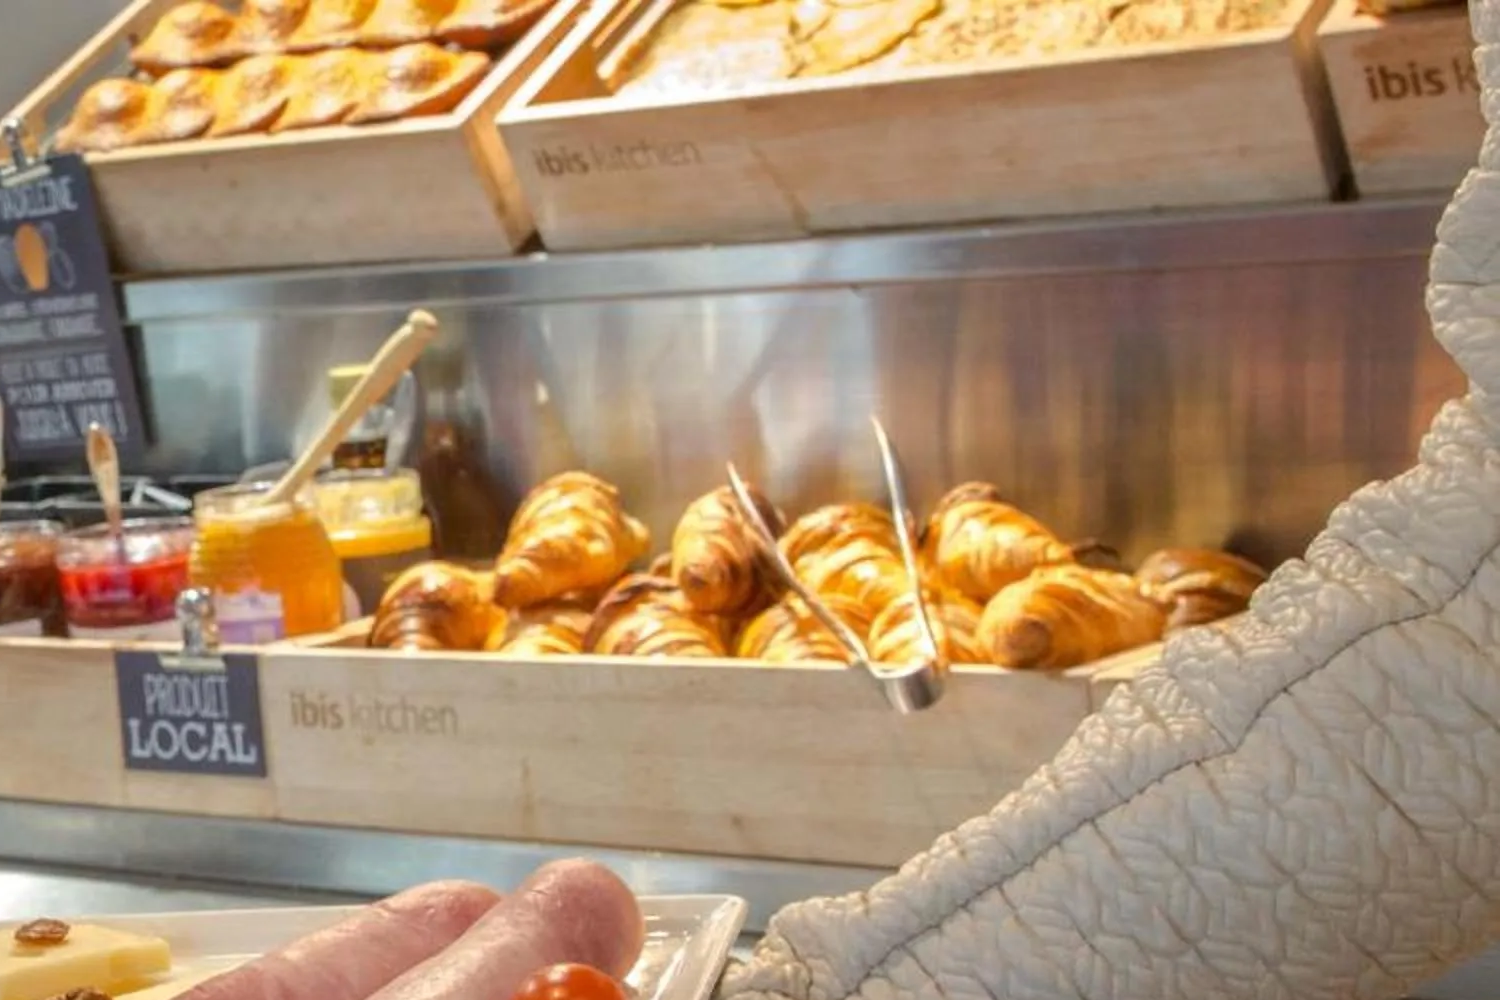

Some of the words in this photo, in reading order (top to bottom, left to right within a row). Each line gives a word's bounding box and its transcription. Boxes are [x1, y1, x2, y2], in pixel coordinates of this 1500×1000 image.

[1364, 62, 1447, 102] ibis
[289, 690, 345, 731] ibis
[128, 716, 259, 764] LOCAL
